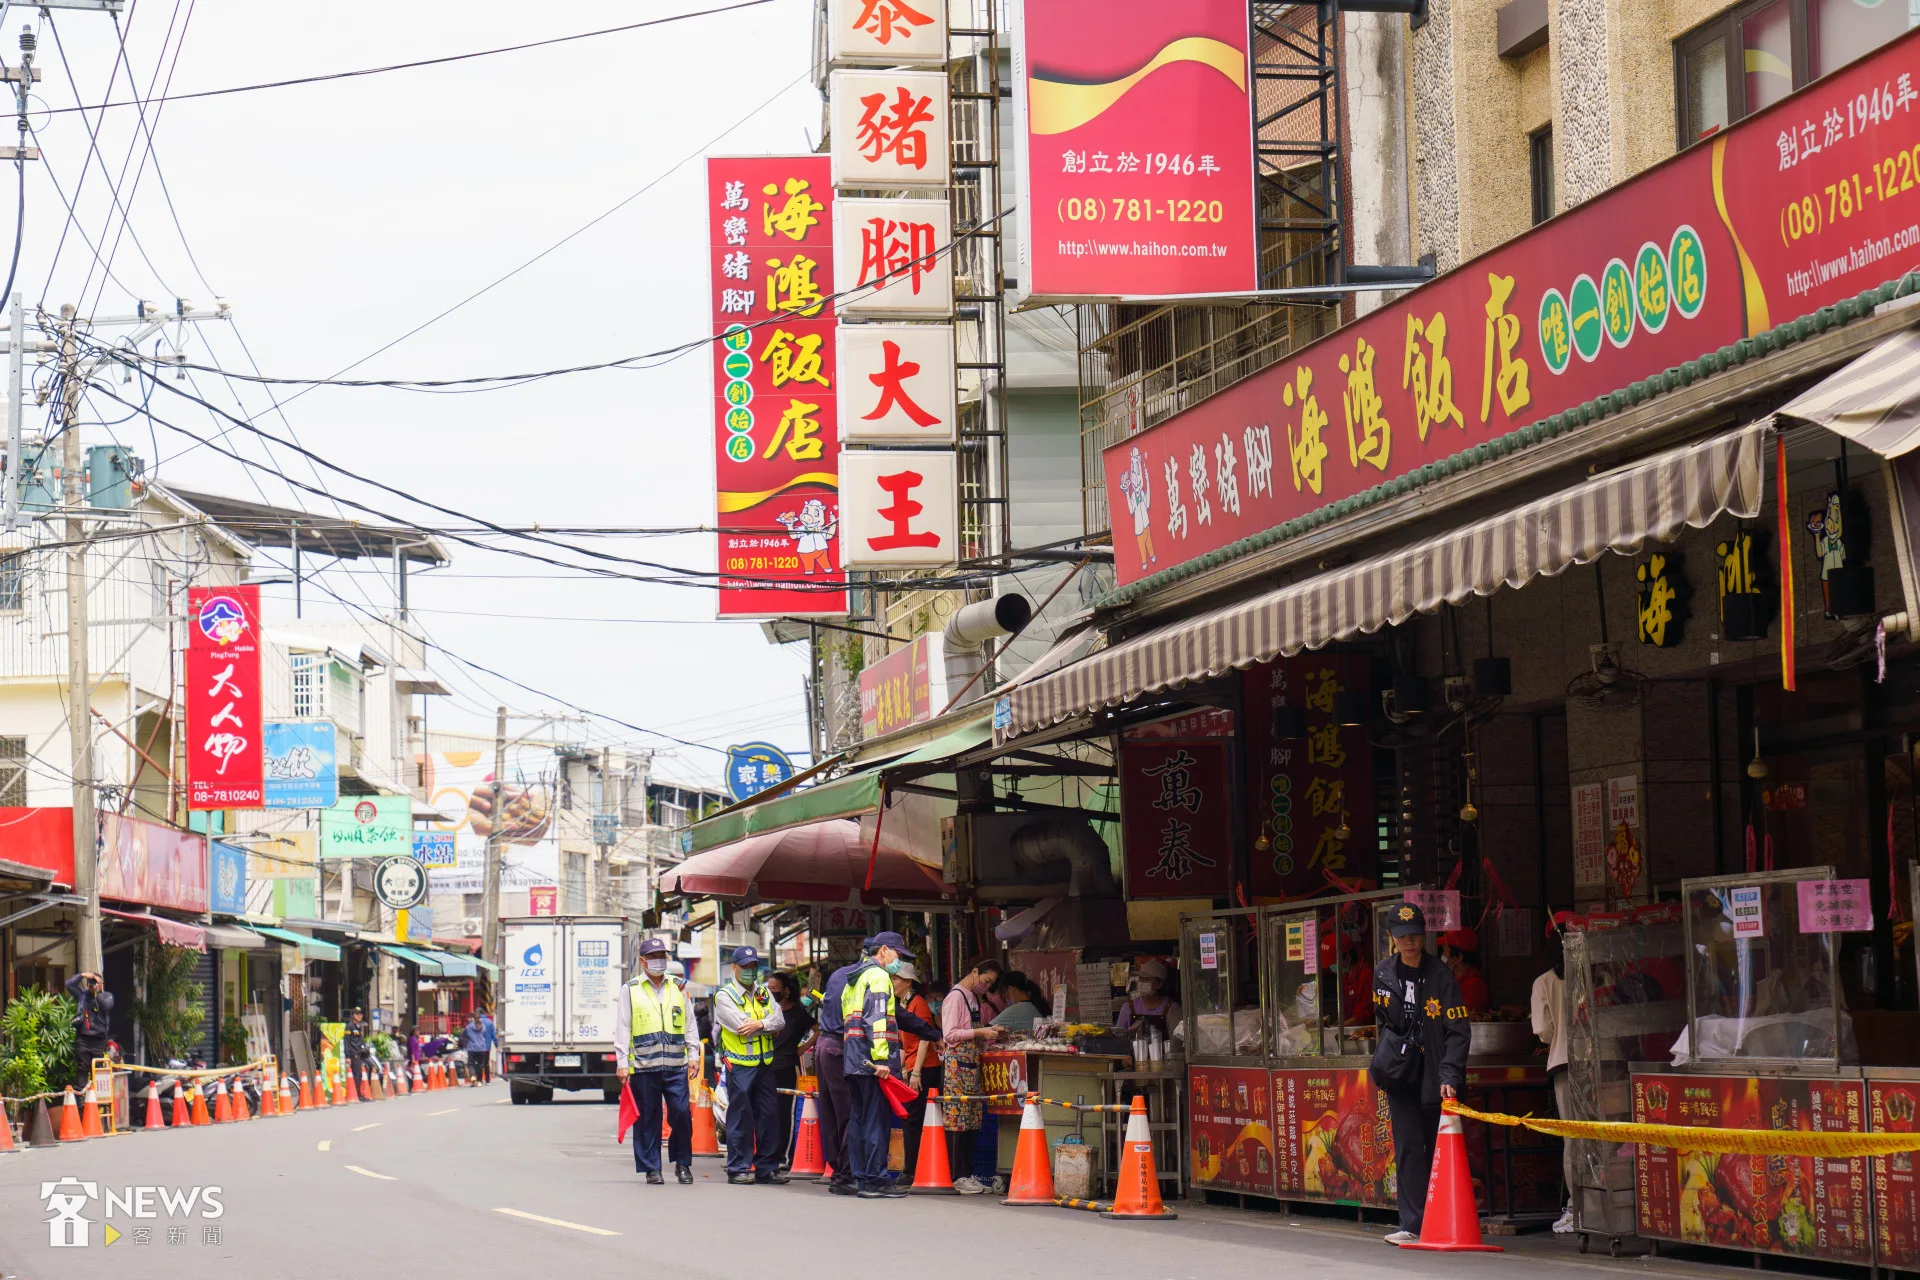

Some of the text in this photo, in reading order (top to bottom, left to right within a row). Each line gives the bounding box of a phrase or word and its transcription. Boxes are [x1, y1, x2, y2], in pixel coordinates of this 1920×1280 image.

[1062, 149, 1221, 177] 創立於1946年
[1776, 73, 1919, 171] 創立於1946年
[720, 182, 755, 314] 萬巒豬腳
[1058, 197, 1223, 224] (08) 781-1220
[1058, 240, 1228, 258] http:\\www.haihon.com.tw
[1781, 193, 1822, 247] (08)
[760, 177, 832, 461] 海鴻飯店
[1541, 232, 1704, 372] 唯一創始店
[726, 328, 752, 459] 唯一創始店
[1283, 272, 1532, 494] 海鴻飯店
[1163, 424, 1273, 541] 萬巒豬腳
[726, 556, 799, 572] (08) 781-1220
[728, 538, 790, 549] 創立於1946年
[210, 651, 240, 660] PingTung
[1269, 668, 1292, 767] 萬巒腳
[194, 789, 260, 802] 08-7810240
[1141, 750, 1217, 880] 萬泰
[578, 1026, 598, 1037] 9915
[1635, 1082, 1652, 1229] 享用御級的古早風味
[1812, 1090, 1827, 1249] 總統臨指定店
